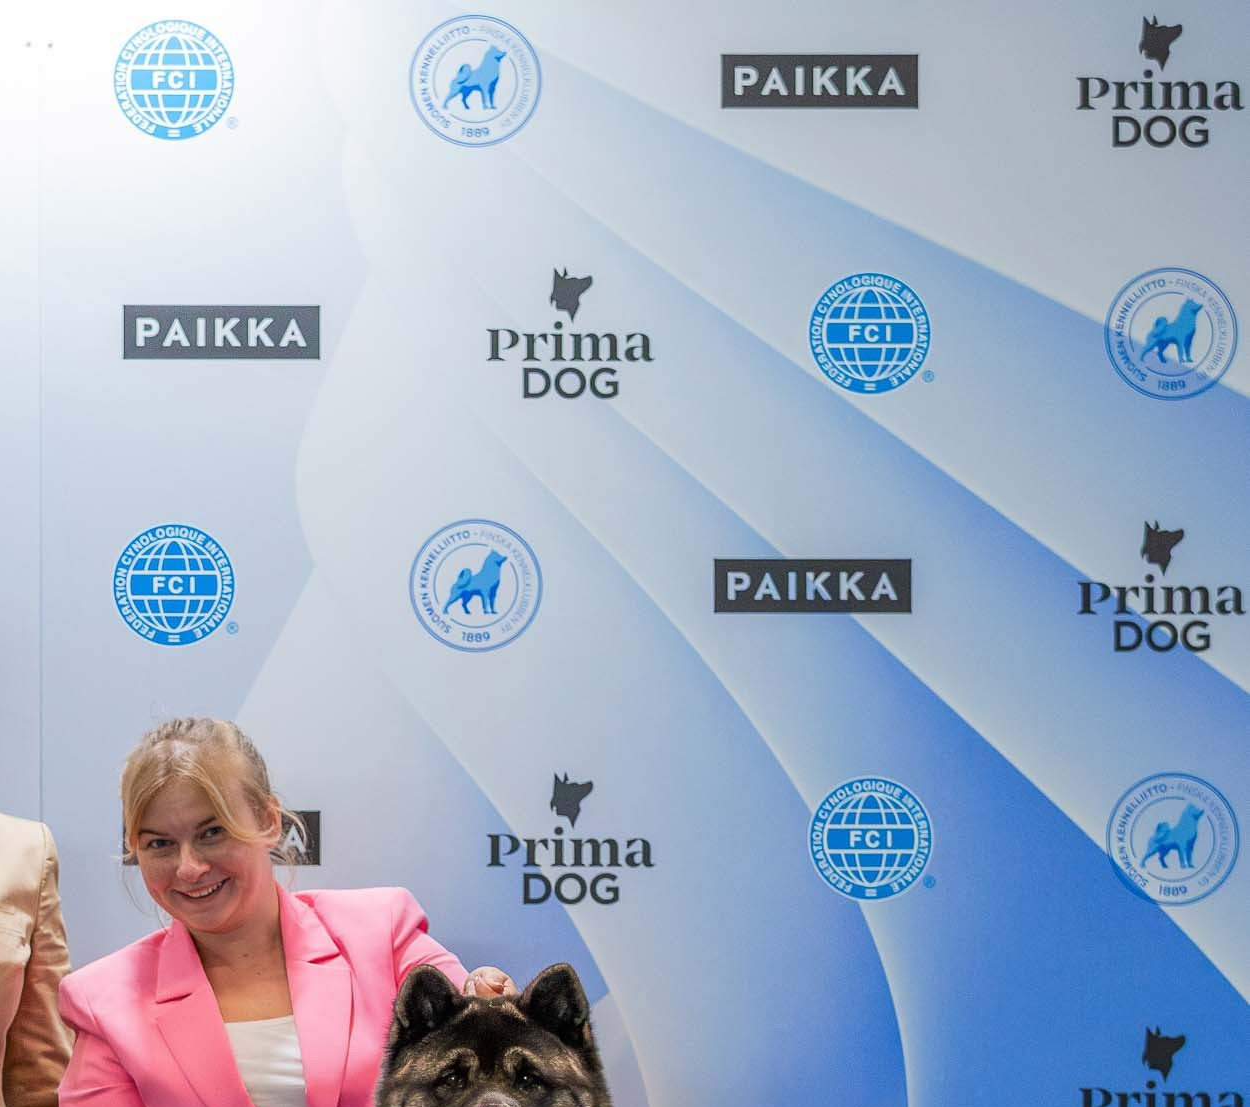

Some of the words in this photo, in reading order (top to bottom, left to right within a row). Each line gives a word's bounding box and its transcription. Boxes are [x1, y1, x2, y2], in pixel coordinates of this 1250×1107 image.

[153, 71, 196, 89] FCI
[734, 66, 907, 96] PAIKKA
[1076, 69, 1246, 110] Prima
[1113, 115, 1210, 147] DOG
[817, 275, 901, 313] CYNOLOGIQUE
[135, 317, 308, 347] PAIKKA
[486, 321, 656, 362] Prima
[848, 324, 891, 342] FCI
[523, 367, 620, 399] DOG
[121, 527, 205, 565] CYNOLOGIQUE
[191, 540, 232, 639] INTERNATIONALE
[152, 576, 195, 594] FCI
[726, 571, 899, 601] PAIKKA
[1077, 574, 1247, 615] Prima
[419, 592, 452, 634] SUOMEN
[461, 631, 490, 643] 1889
[1114, 620, 1211, 652] DOG
[486, 827, 656, 868] Prima
[849, 830, 892, 848] FCI
[523, 873, 620, 905] DOG
